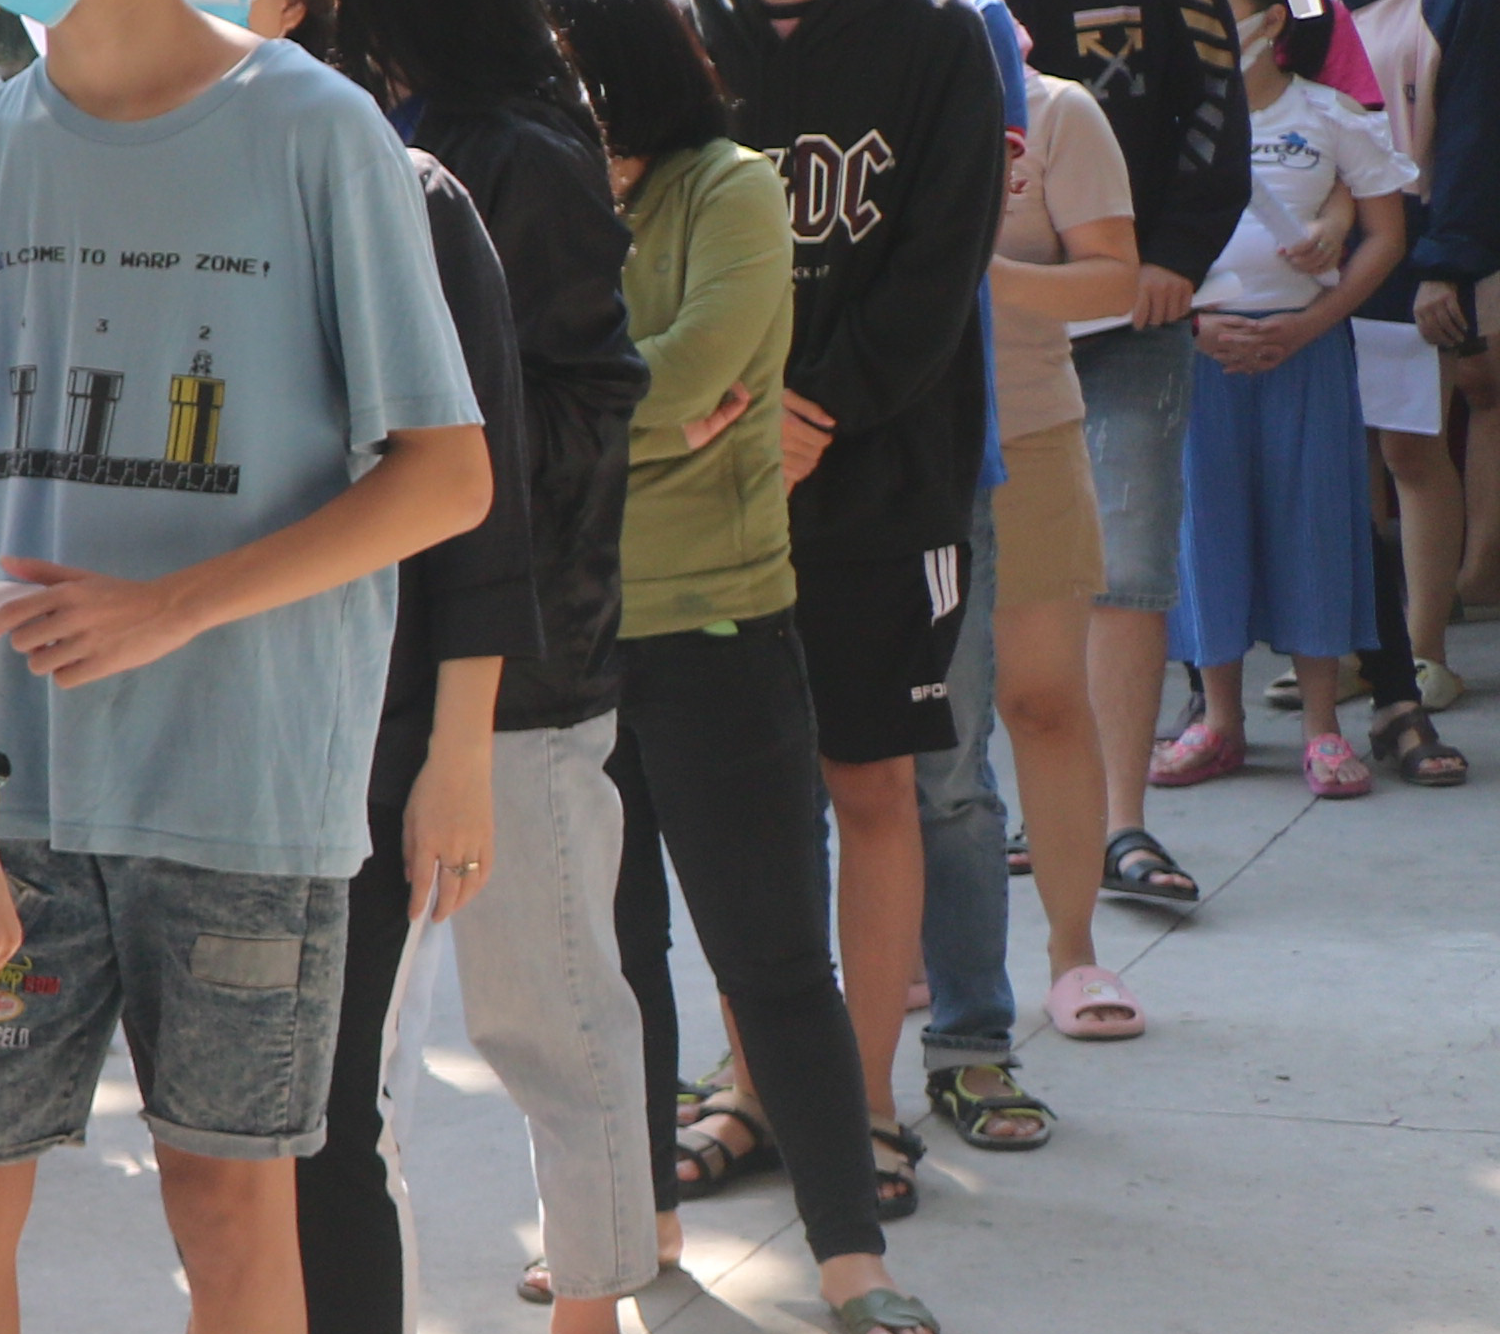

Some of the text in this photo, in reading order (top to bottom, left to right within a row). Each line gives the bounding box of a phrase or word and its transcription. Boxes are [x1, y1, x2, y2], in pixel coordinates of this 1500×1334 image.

[78, 247, 106, 266] TO
[120, 251, 181, 270] WARP
[95, 317, 211, 341] 3 2
